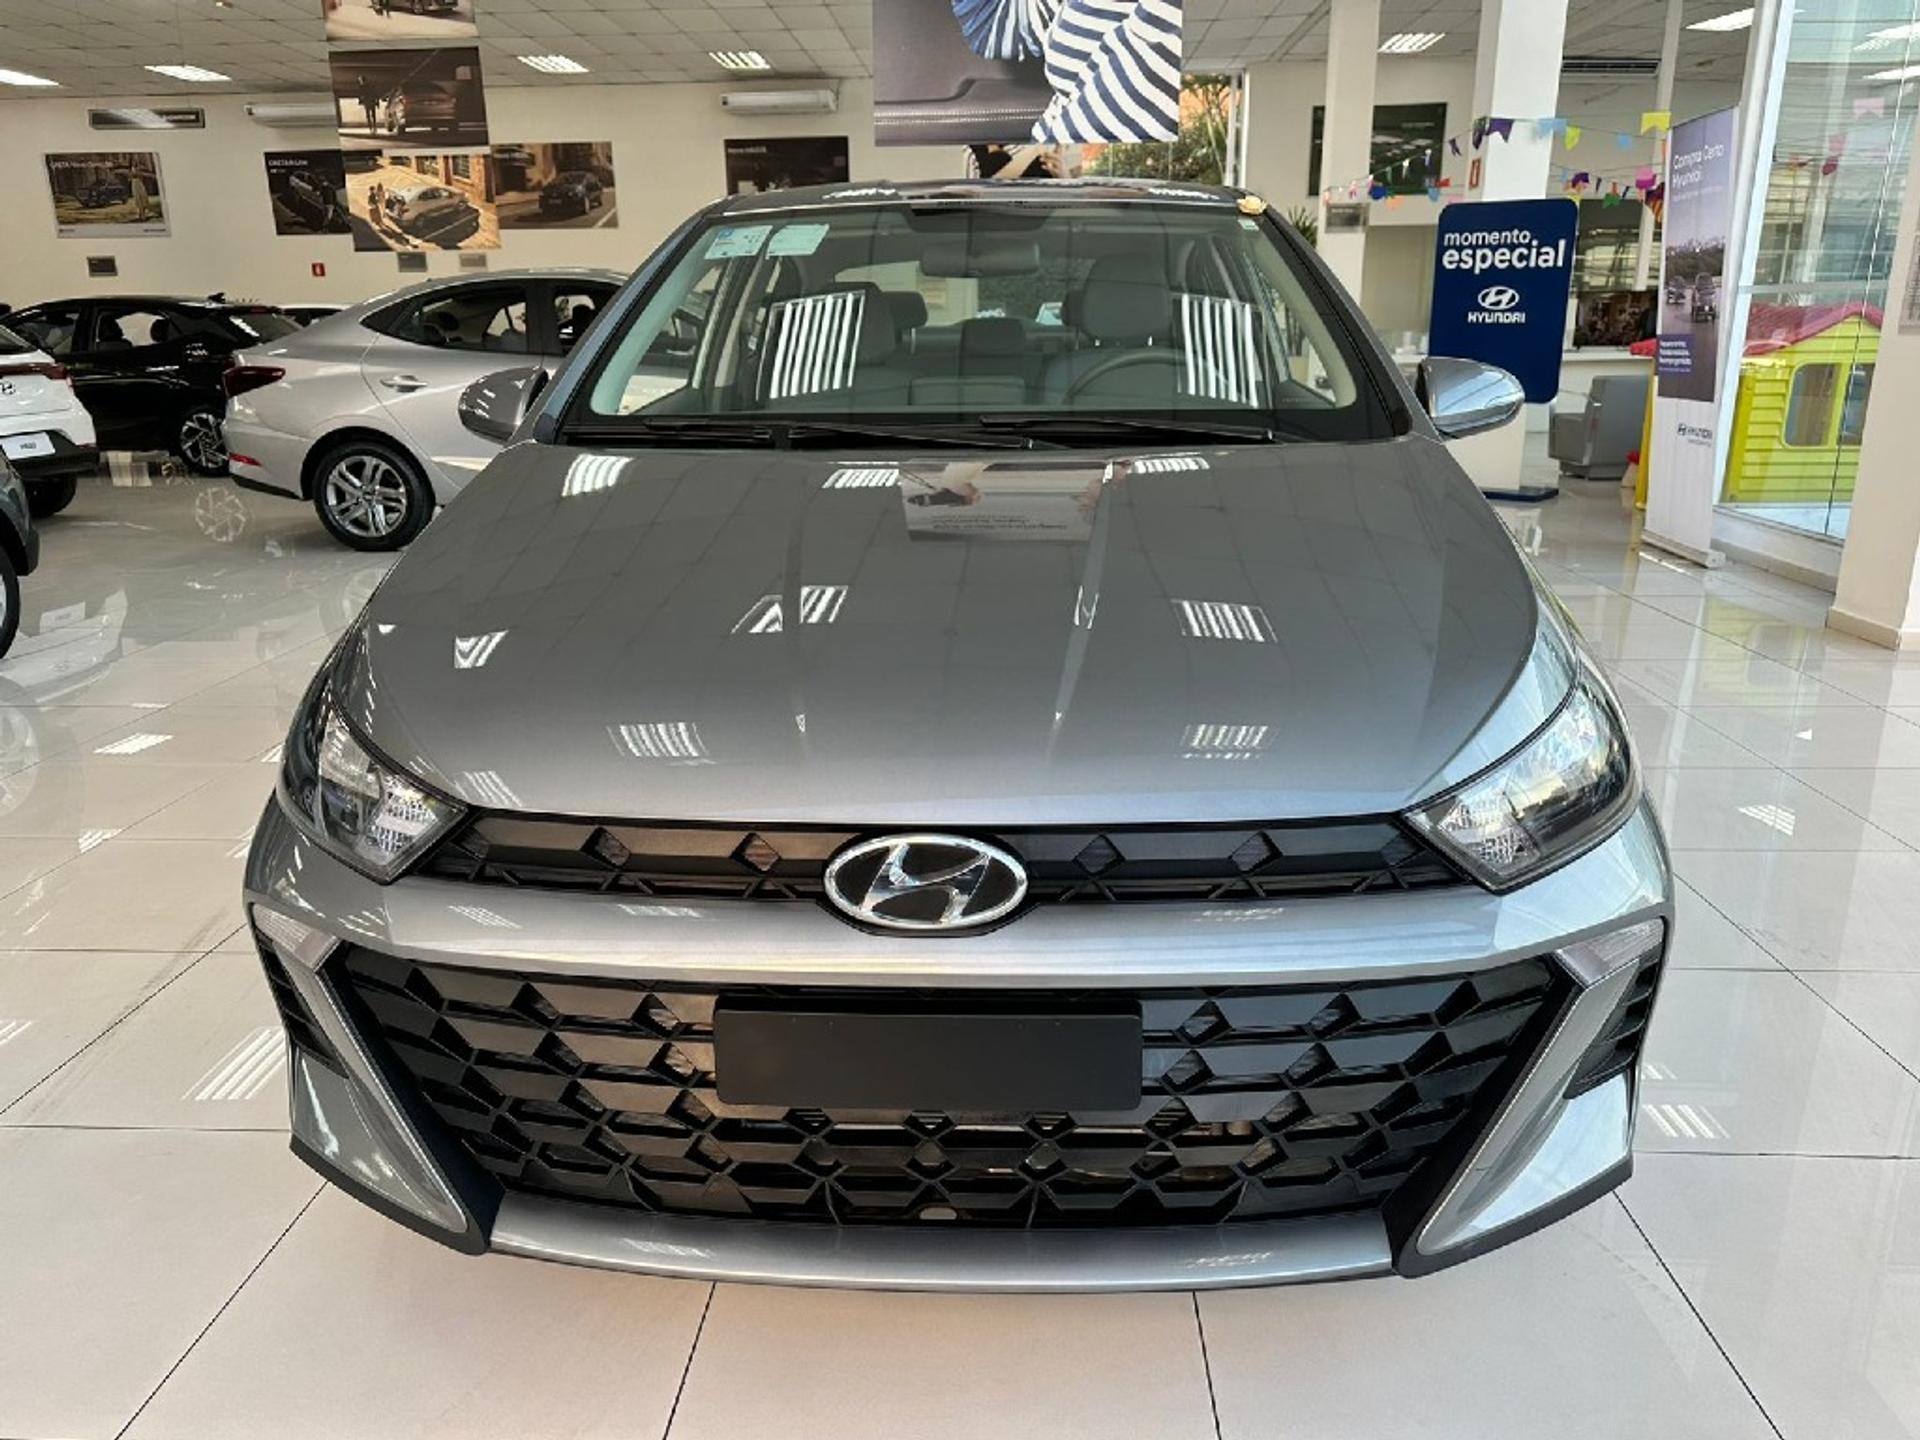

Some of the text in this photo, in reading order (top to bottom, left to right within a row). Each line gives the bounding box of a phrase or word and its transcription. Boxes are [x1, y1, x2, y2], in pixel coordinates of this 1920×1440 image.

[1444, 229, 1531, 246] momento
[1442, 239, 1566, 275] especial
[1467, 312, 1526, 324] HYUNDAI
